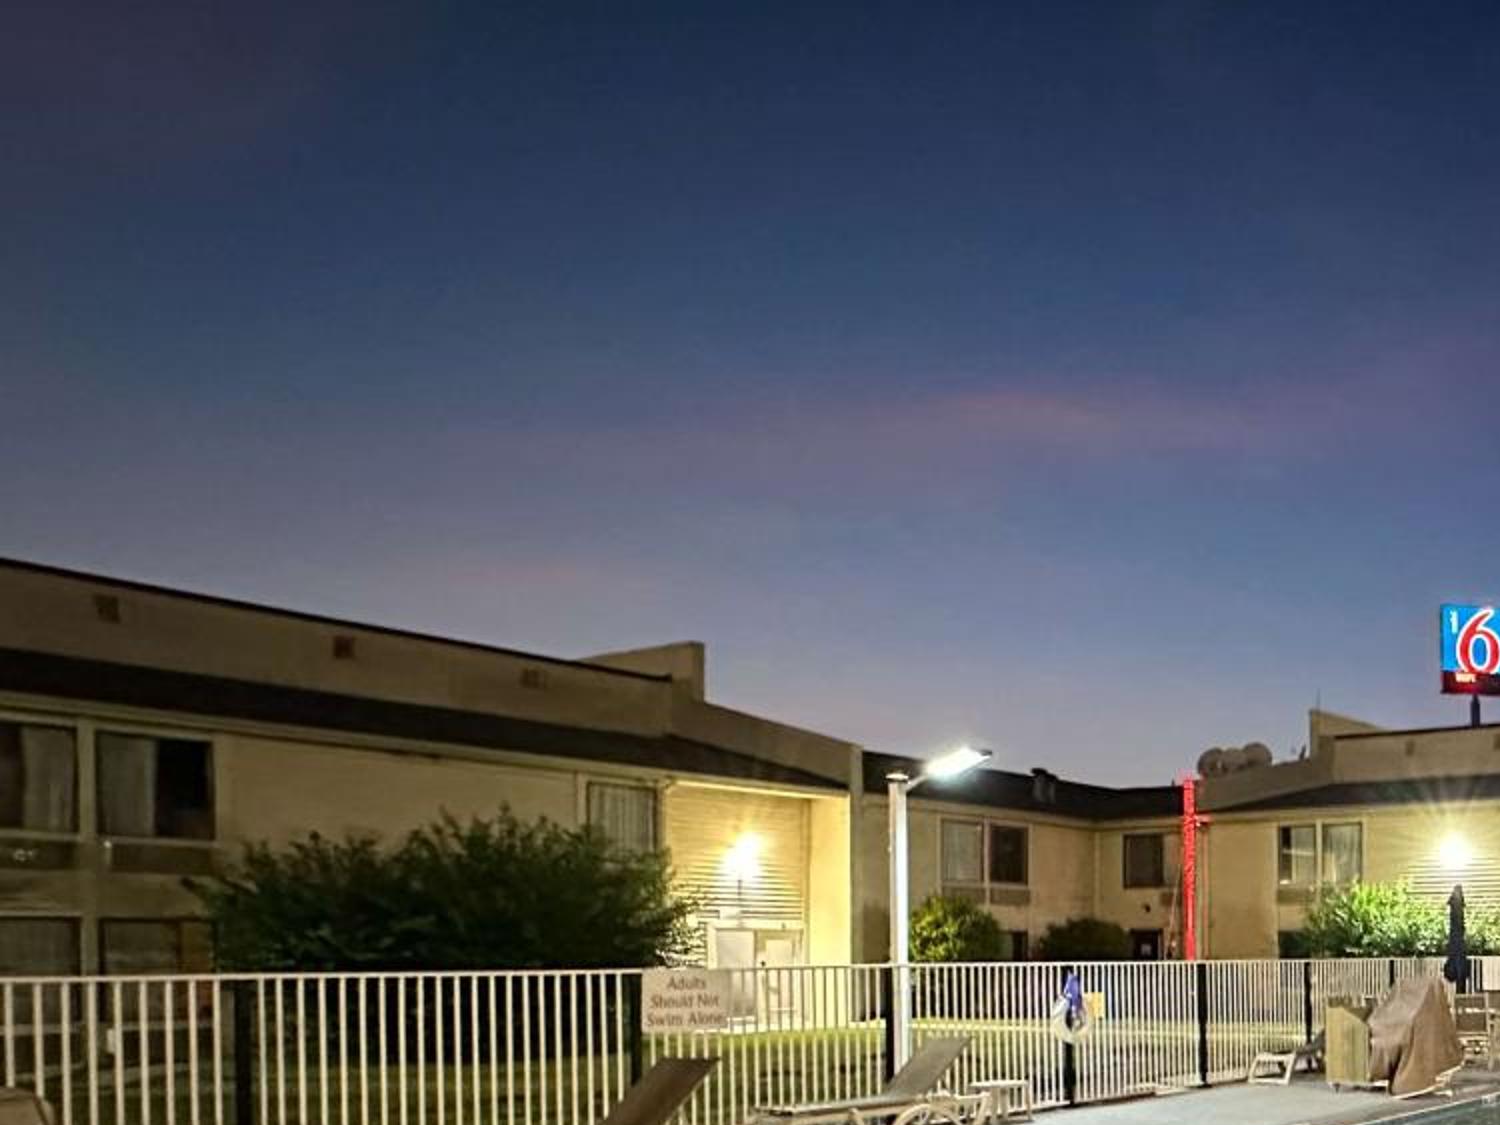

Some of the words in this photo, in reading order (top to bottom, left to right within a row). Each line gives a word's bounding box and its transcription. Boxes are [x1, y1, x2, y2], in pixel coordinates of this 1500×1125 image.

[666, 975, 707, 990] Adults
[650, 993, 693, 1009] Should
[697, 993, 720, 1008] Not
[647, 1011, 683, 1026] Swim
[688, 1011, 728, 1026] Alone
